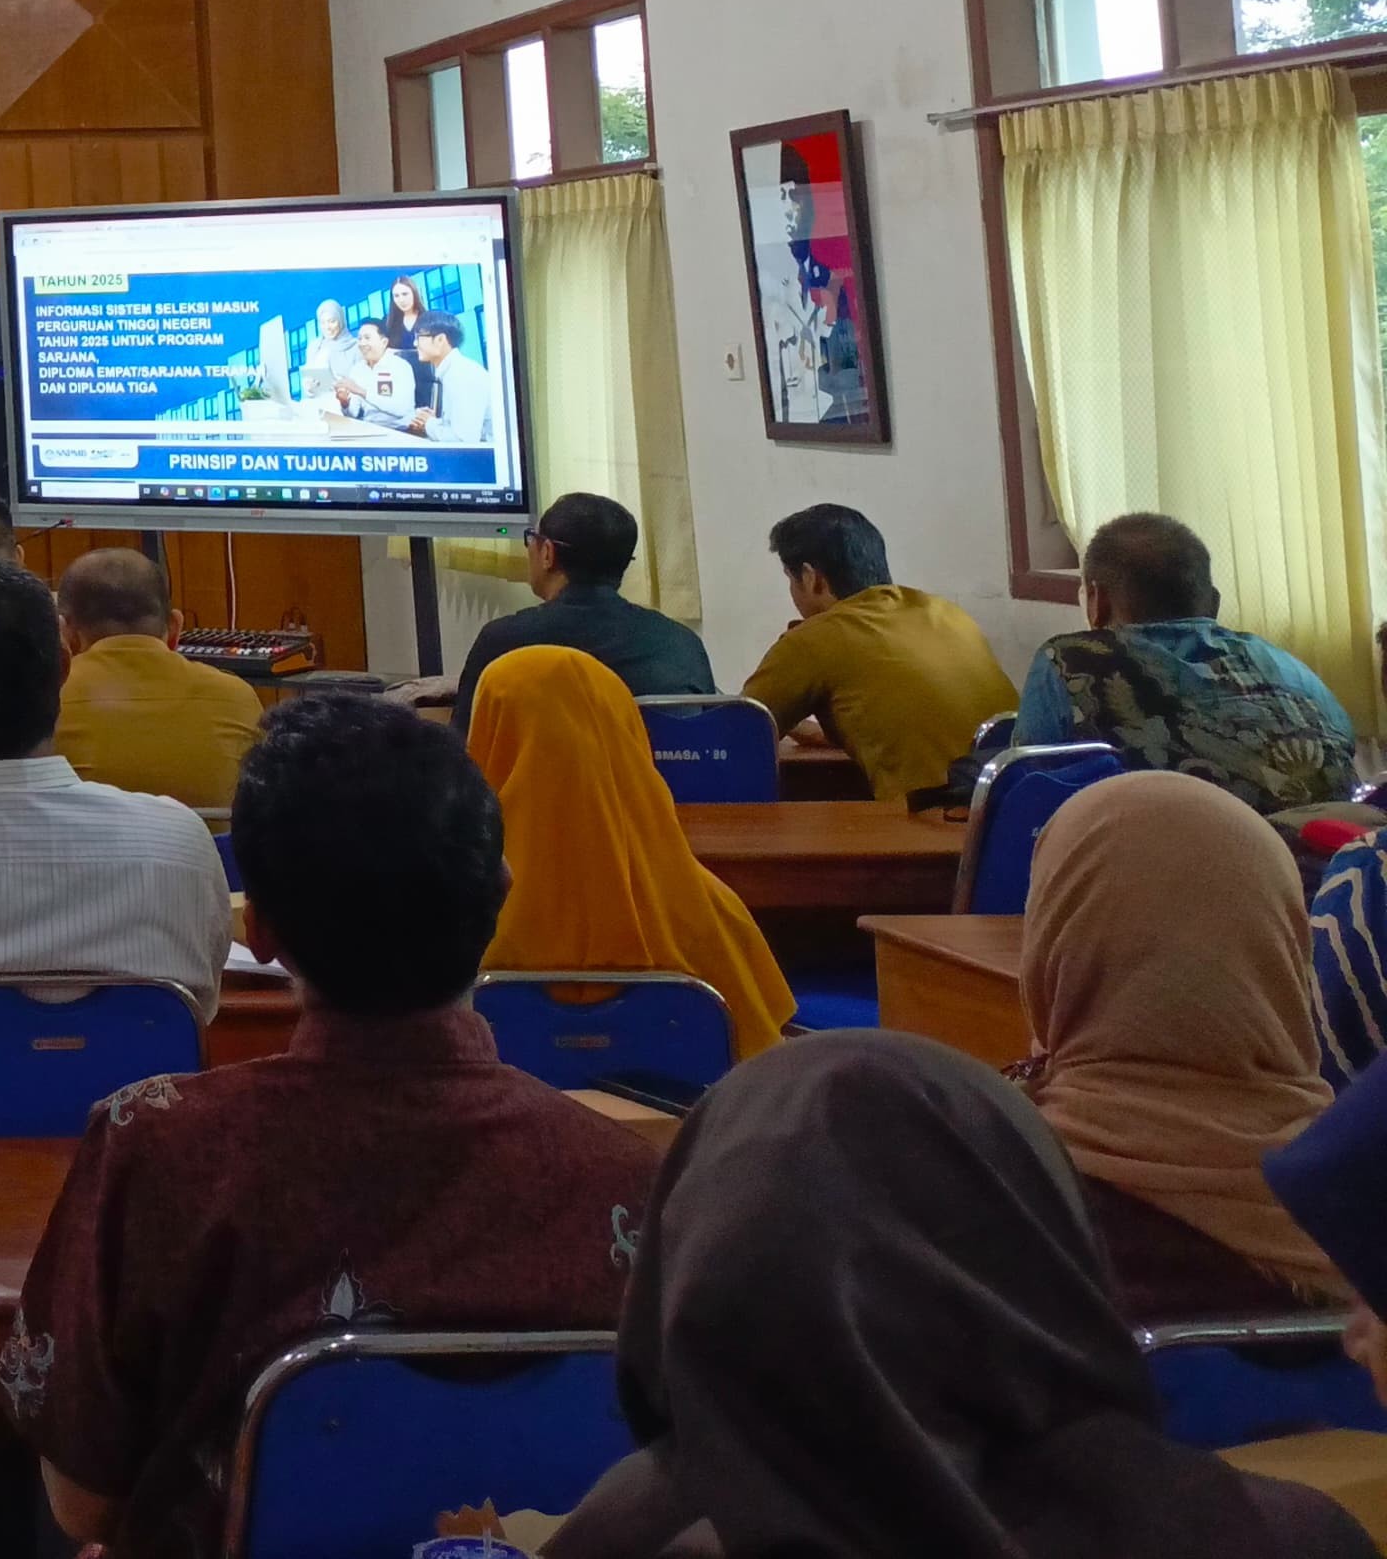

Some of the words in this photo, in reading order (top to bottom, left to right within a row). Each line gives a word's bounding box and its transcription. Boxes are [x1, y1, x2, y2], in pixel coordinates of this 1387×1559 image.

[39, 275, 87, 287] TAHUN
[91, 273, 123, 286] 2025
[35, 305, 103, 317] INFORMASI
[106, 303, 152, 316] SISTEM
[155, 302, 209, 315] SELEKSI
[211, 300, 260, 313] MASUK
[36, 320, 114, 332] PERGURUAN
[117, 318, 160, 333] TINGGI
[162, 317, 212, 330] NEGERI
[37, 336, 79, 348] TAHUN
[81, 335, 109, 347] 2025
[111, 334, 155, 346] UNTUK
[157, 333, 224, 345] PROGRAM
[38, 351, 100, 364] SARJANA,
[39, 367, 94, 379] DIPLOMA
[97, 365, 202, 378] EMPAT/SARJANA
[39, 382, 67, 394] DAN
[69, 381, 126, 394] DIPLOMA
[128, 380, 158, 393] TIGA
[169, 453, 237, 470] PRINSIP
[241, 454, 279, 470] DAN
[283, 455, 357, 471] TUJUAN
[361, 456, 429, 473] SNPMB
